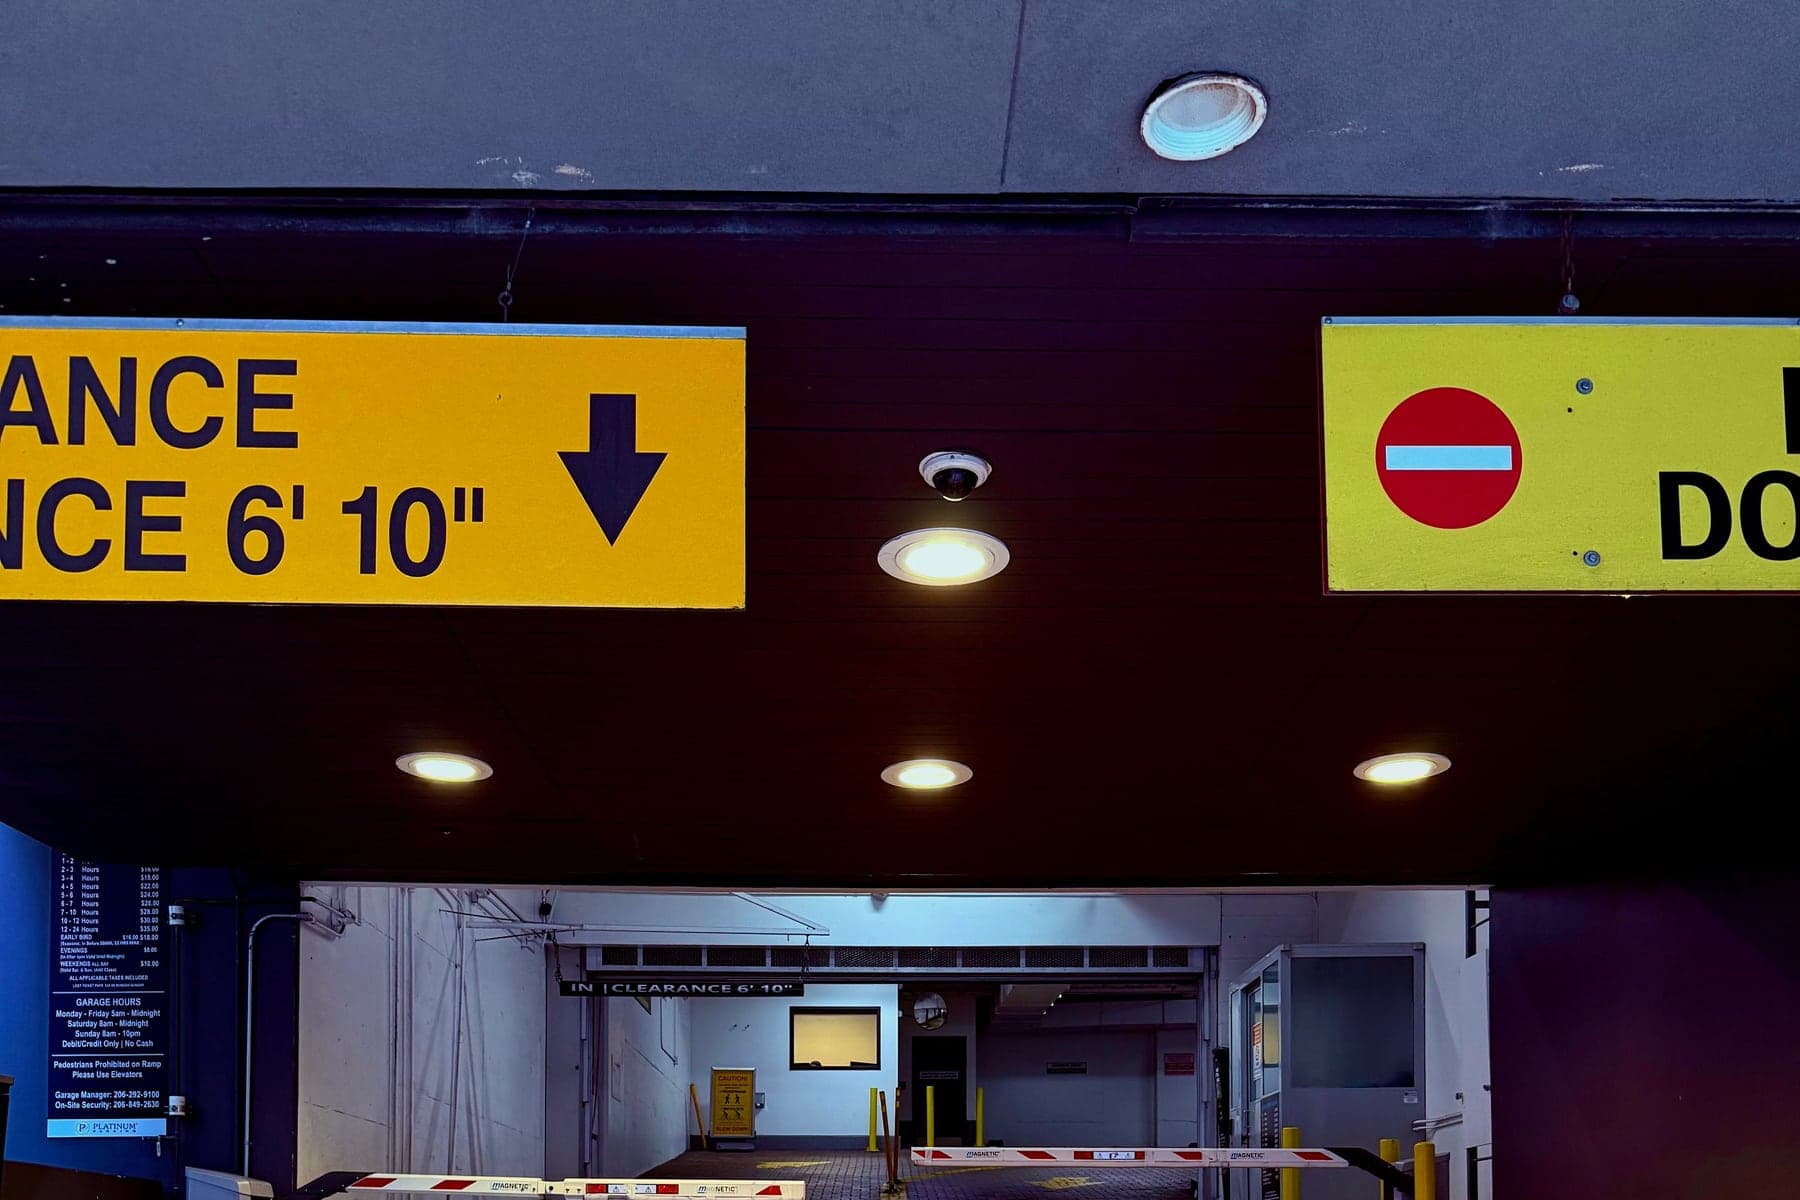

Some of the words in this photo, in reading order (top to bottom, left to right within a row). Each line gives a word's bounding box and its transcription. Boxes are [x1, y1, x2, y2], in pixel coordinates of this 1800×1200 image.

[0, 355, 299, 449] ANCE
[1659, 470, 1800, 561] DO
[227, 484, 304, 575] 6'
[341, 486, 484, 577] 10"
[81, 917, 99, 925] Hours
[571, 983, 593, 992] IN
[611, 984, 731, 993] CLEARANCE
[737, 984, 754, 993] 6'
[760, 984, 793, 993] 10"
[76, 998, 111, 1006] GARAGE
[113, 998, 141, 1006] HOURS
[56, 1010, 83, 1019] Monday
[88, 1010, 109, 1019] Friday
[131, 1009, 161, 1018] Midnight
[67, 1020, 97, 1029] Saturday
[119, 1019, 149, 1029] Midnight
[75, 1030, 100, 1039] Sunday
[62, 1040, 103, 1048] Debit/Credit
[103, 1039, 119, 1048] Only
[136, 1039, 154, 1047] Cash
[53, 1060, 94, 1069] Pedestrians
[95, 1060, 130, 1069] Prohibited
[141, 1060, 161, 1069] Ramp
[72, 1070, 95, 1078] Please
[96, 1070, 110, 1078] Use
[111, 1070, 142, 1078] Elevators
[55, 1091, 80, 1100] Garage
[80, 1090, 112, 1100] Manager:
[55, 1101, 80, 1109] On-Site
[81, 1101, 112, 1110] Security:
